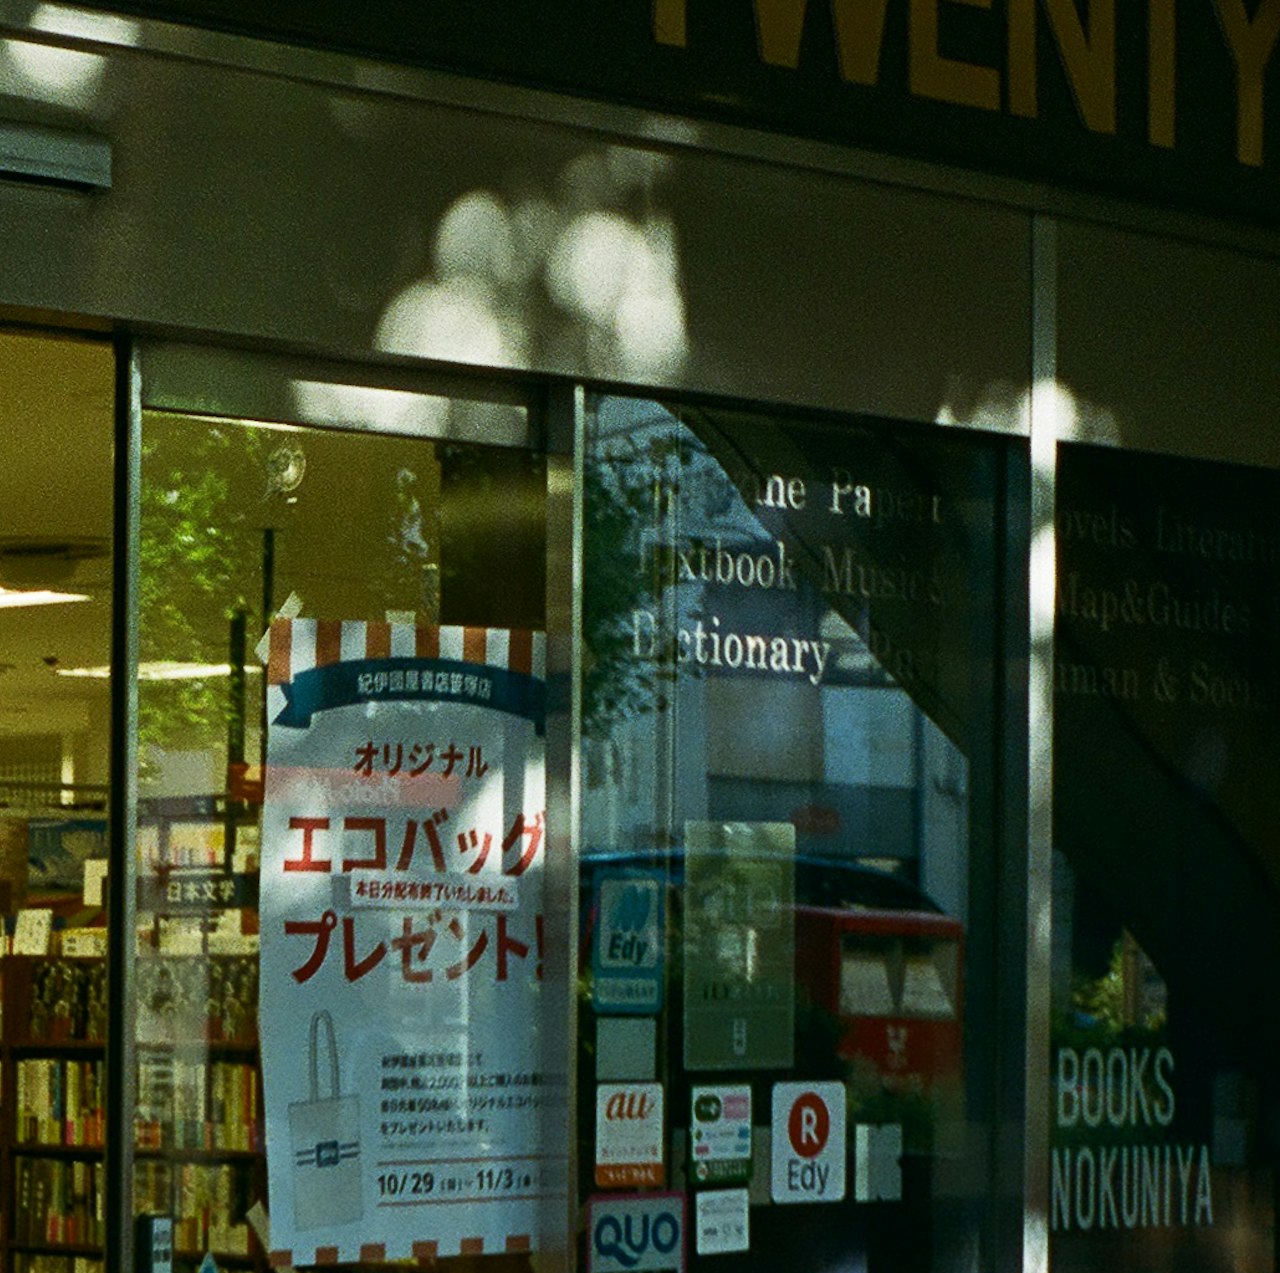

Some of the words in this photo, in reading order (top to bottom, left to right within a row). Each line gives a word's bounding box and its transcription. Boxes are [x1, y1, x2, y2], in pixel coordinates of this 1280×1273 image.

[635, 526, 797, 590] Txtbook
[632, 608, 831, 685] Dctionary
[353, 741, 489, 778] オリジナル
[282, 807, 546, 878] エコバッグ
[166, 880, 235, 903] 日本文学
[284, 910, 546, 986] プレゼント!
[608, 933, 648, 965] Edy
[605, 1092, 648, 1122] au
[1057, 1045, 1176, 1128] BOOKS
[787, 1159, 831, 1195] Edy
[594, 1212, 680, 1267] QUO
